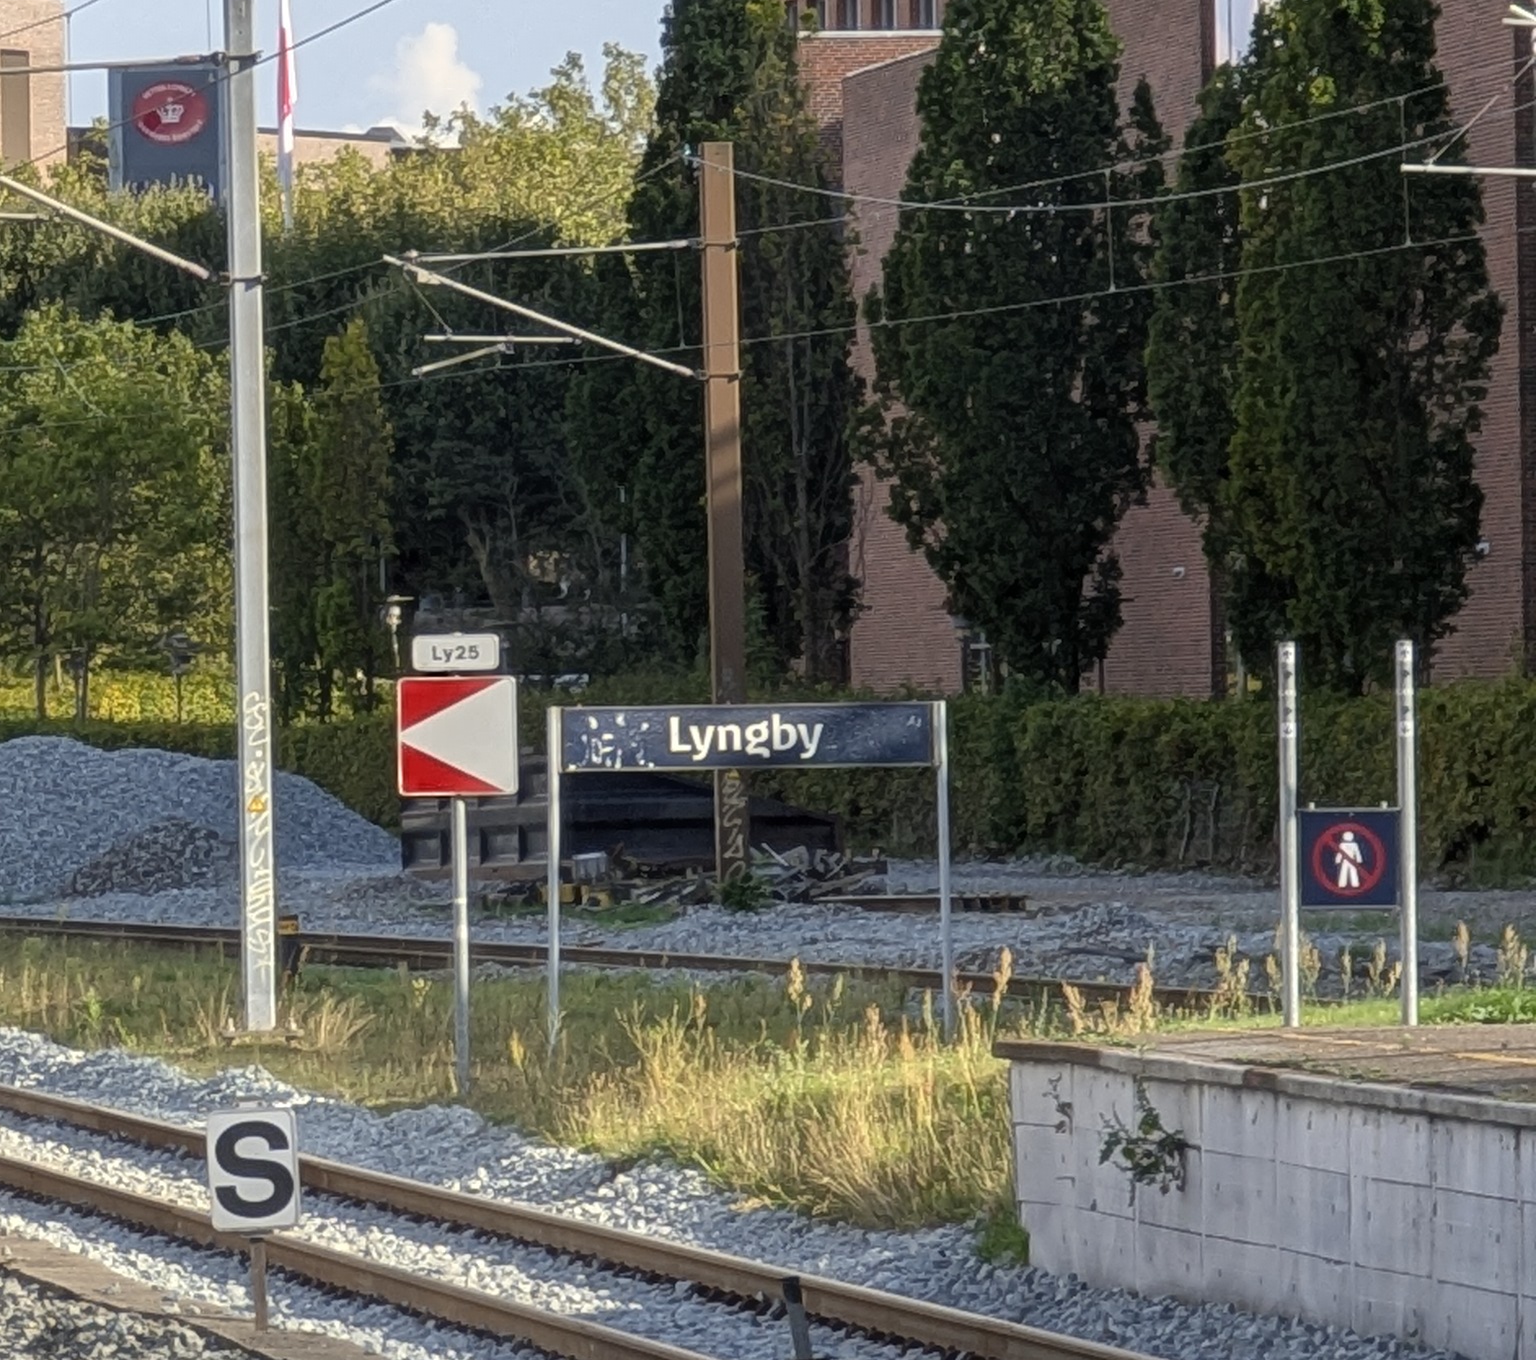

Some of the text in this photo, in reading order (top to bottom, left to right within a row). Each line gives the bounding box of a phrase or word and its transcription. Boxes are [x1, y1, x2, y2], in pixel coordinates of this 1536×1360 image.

[431, 644, 480, 663] Ly25
[669, 713, 825, 762] Lyngby
[214, 1120, 295, 1219] S
